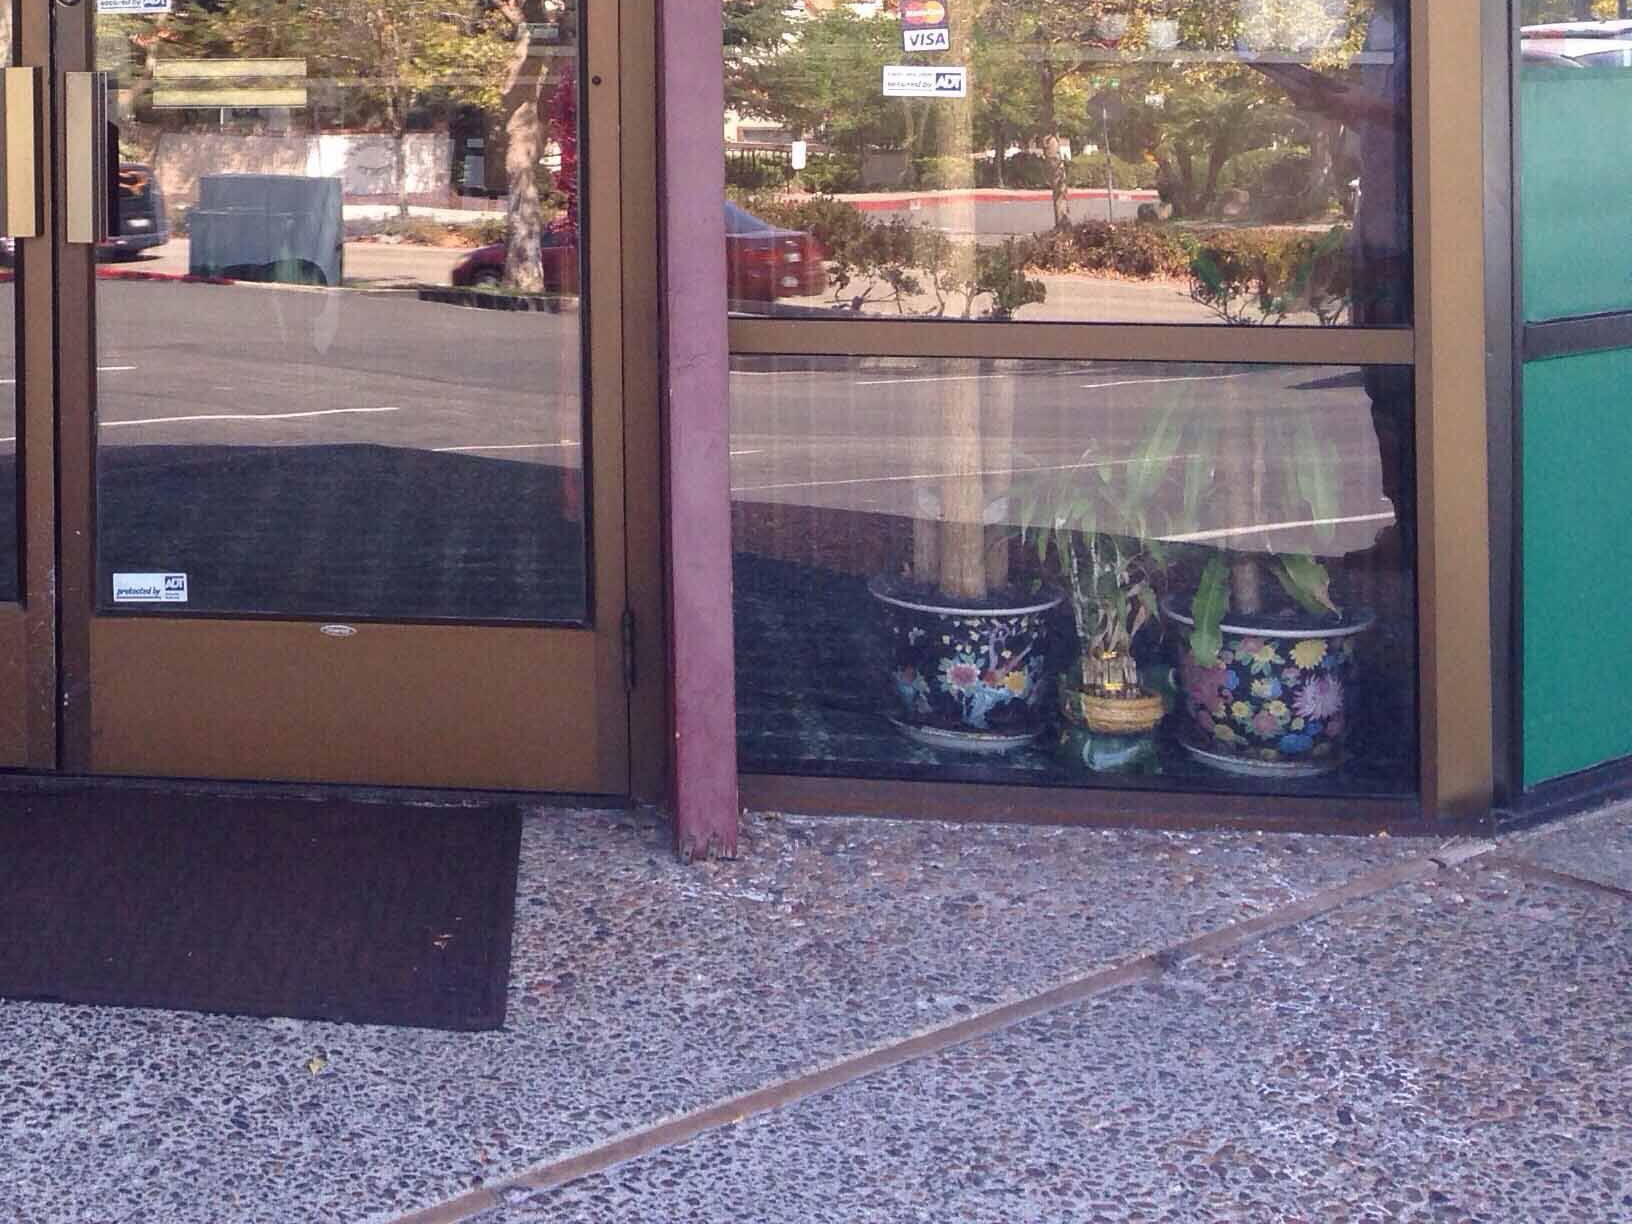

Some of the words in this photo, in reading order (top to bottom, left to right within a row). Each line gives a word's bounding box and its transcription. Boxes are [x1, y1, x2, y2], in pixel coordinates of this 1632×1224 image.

[909, 32, 945, 46] VISA
[936, 73, 961, 90] ADT
[165, 577, 184, 590] ADT
